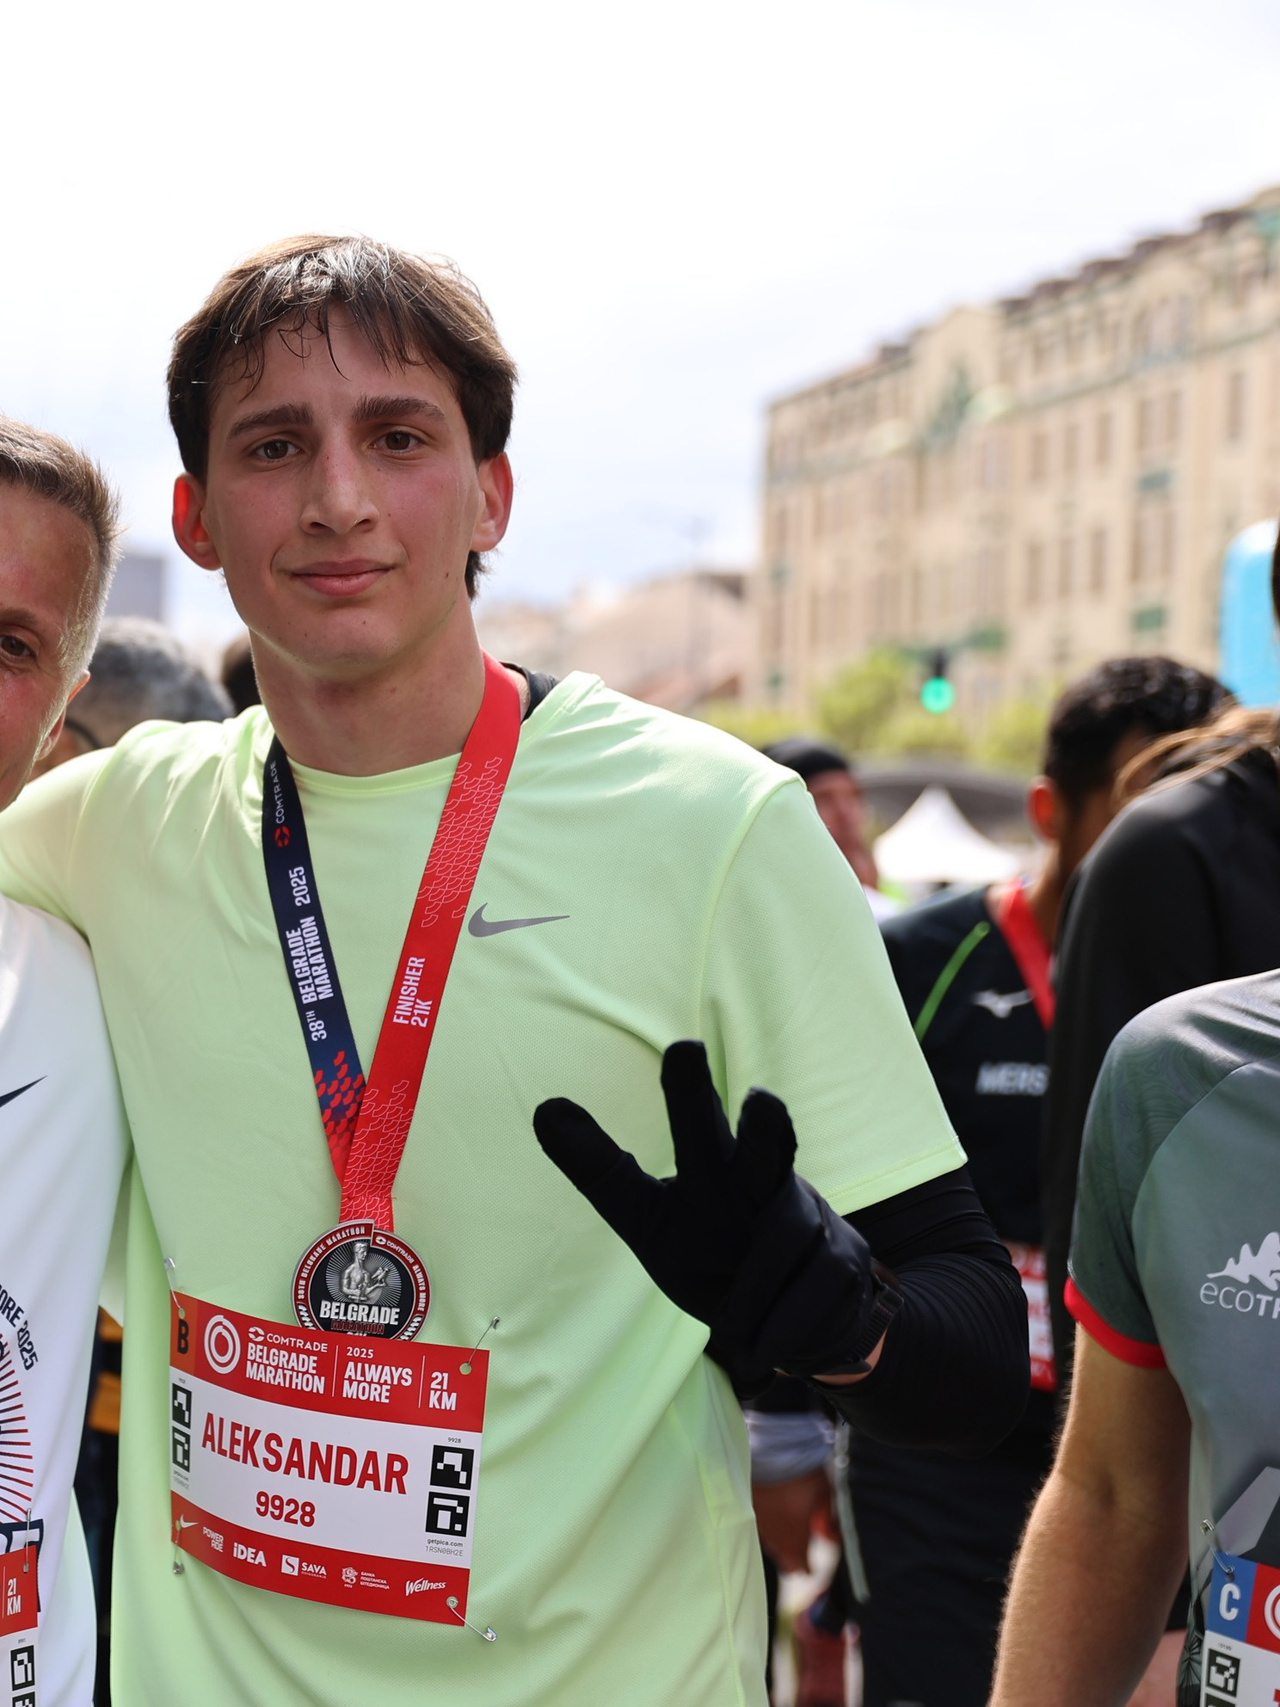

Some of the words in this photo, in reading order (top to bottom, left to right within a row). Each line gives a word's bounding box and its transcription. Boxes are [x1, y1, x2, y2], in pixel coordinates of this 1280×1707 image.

[271, 760, 285, 824] COMTRADE
[288, 866, 311, 906] 2025
[286, 927, 318, 1005] BELGRADE
[300, 916, 334, 1001] MARATHON
[393, 956, 426, 1025] FINISHER
[410, 998, 433, 1028] 21K
[320, 1300, 400, 1325] BELGRADE
[17, 1320, 38, 1371] 2025
[178, 1319, 189, 1355] B
[266, 1333, 328, 1353] COMTRADE
[247, 1344, 317, 1374] BELGRADE
[346, 1346, 374, 1359] 2025
[245, 1364, 326, 1394] MARATHON
[343, 1362, 412, 1387] ALWAYS
[431, 1371, 448, 1390] 21
[342, 1380, 390, 1403] MORE
[429, 1389, 457, 1411] KM
[202, 1412, 409, 1495] ALEKSANDAR
[447, 1436, 461, 1444] 9928
[256, 1491, 316, 1527] 9928
[427, 1538, 463, 1548] getpica.com
[301, 1562, 327, 1575] SAVA
[7, 1578, 17, 1597] 21
[405, 1577, 447, 1596] Wellness
[7, 1594, 22, 1617] KM
[1219, 1582, 1241, 1621] C
